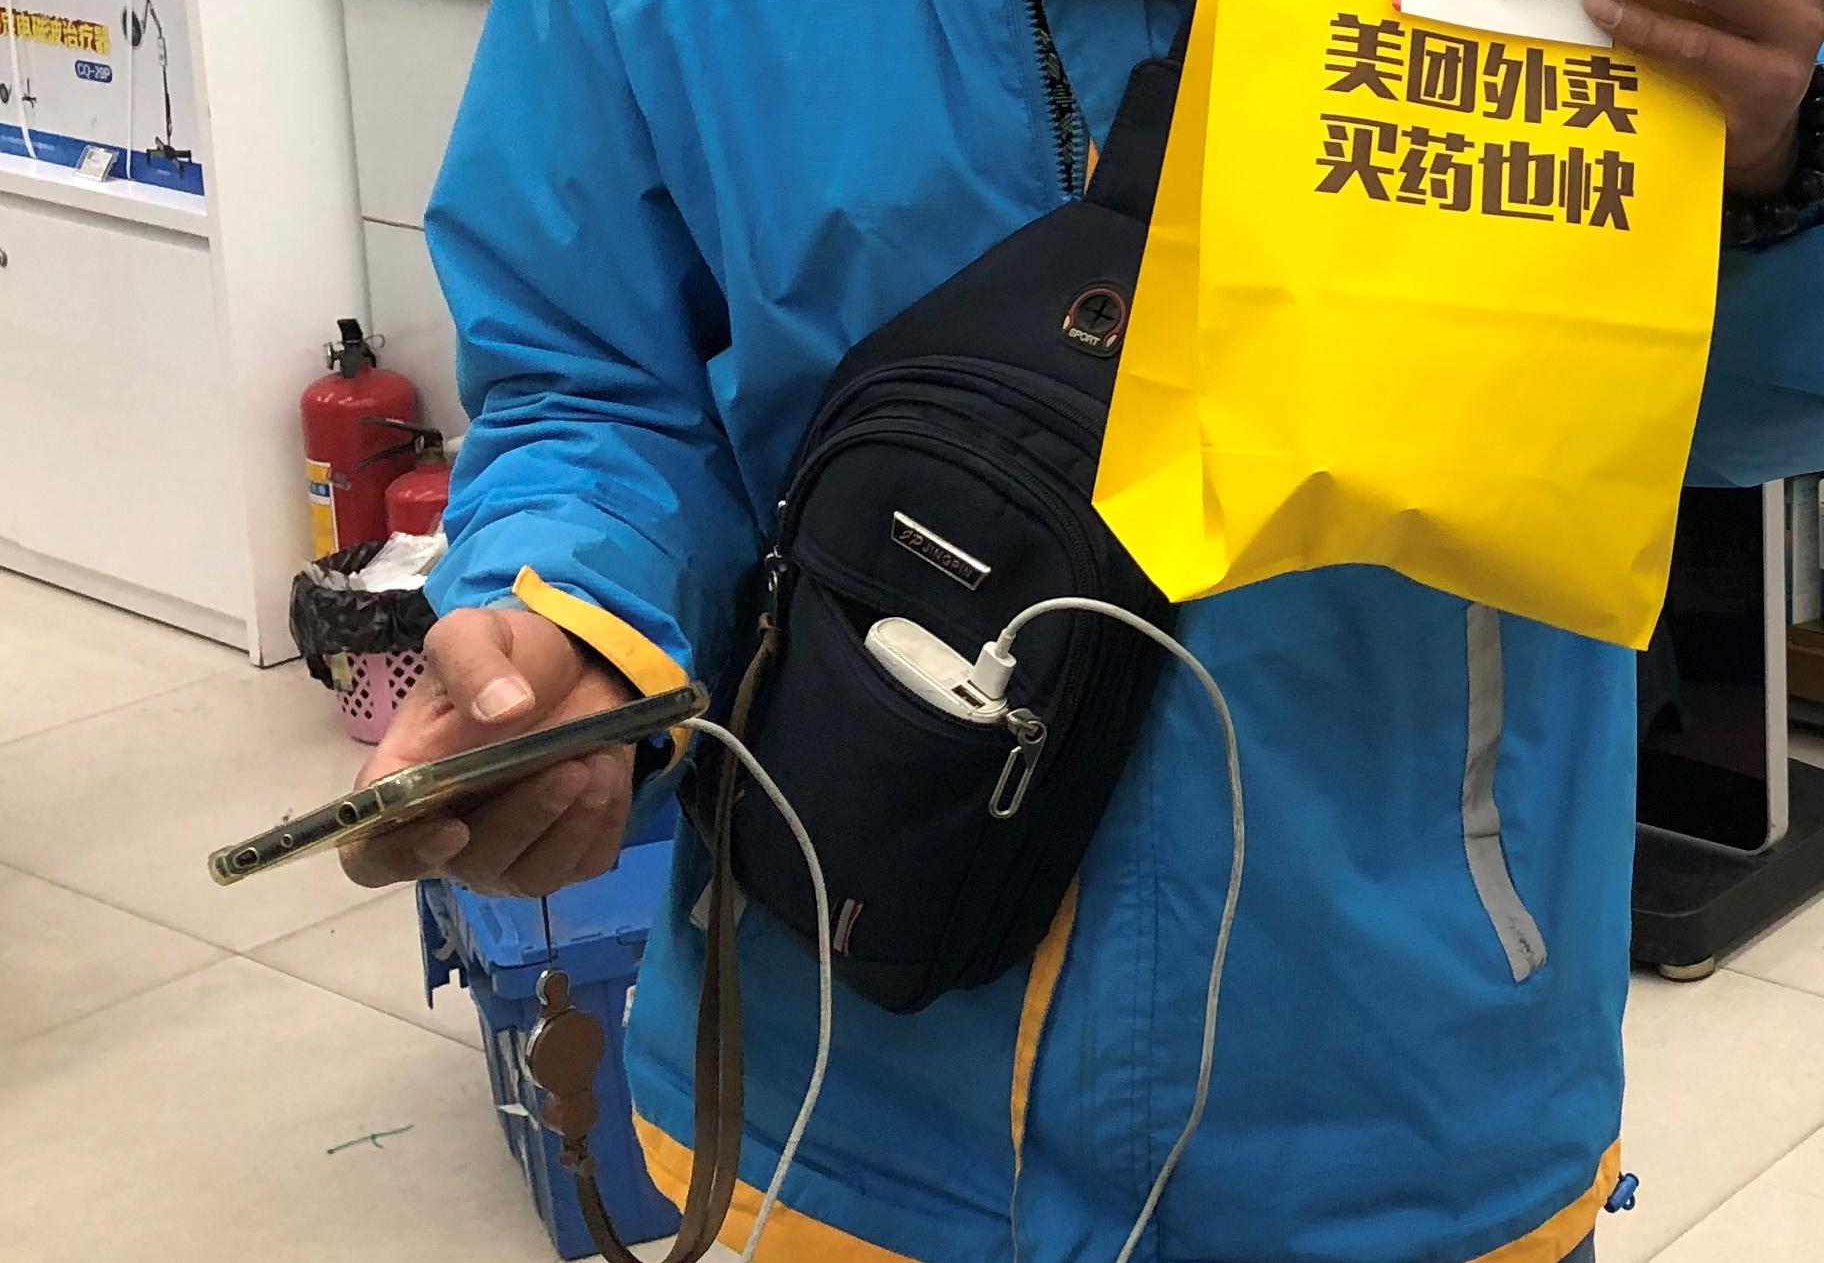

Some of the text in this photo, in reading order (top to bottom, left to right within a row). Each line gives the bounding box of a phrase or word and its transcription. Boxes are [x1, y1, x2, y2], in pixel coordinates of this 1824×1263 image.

[1324, 12, 1639, 135] 美团外卖
[1313, 113, 1636, 232] 买药也快
[1068, 327, 1101, 347] SPORT
